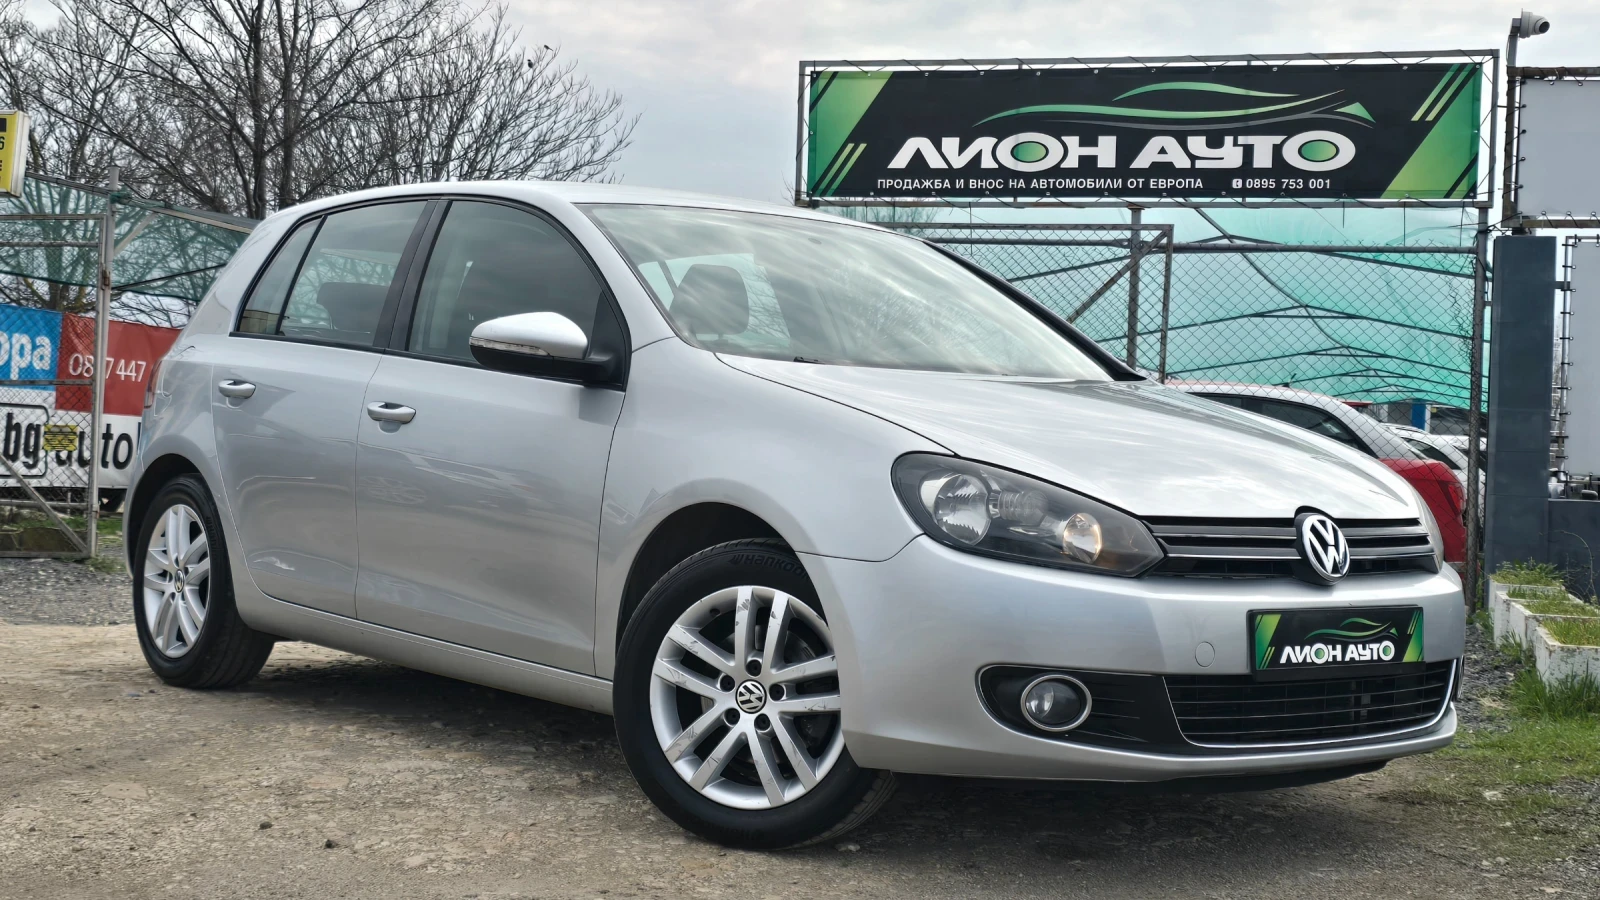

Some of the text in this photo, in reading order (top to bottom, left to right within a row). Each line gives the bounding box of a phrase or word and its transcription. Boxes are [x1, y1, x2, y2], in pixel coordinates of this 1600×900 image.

[887, 130, 1356, 172] ЛИОН АУТО
[877, 178, 1331, 190] ПРОДАЖБА И ВНОС НА АВТОМОБИЛИ ОТ ЕВРОПА 0895 753 001
[3, 412, 42, 469] bg
[1280, 640, 1395, 664] ЛИОН АУТО
